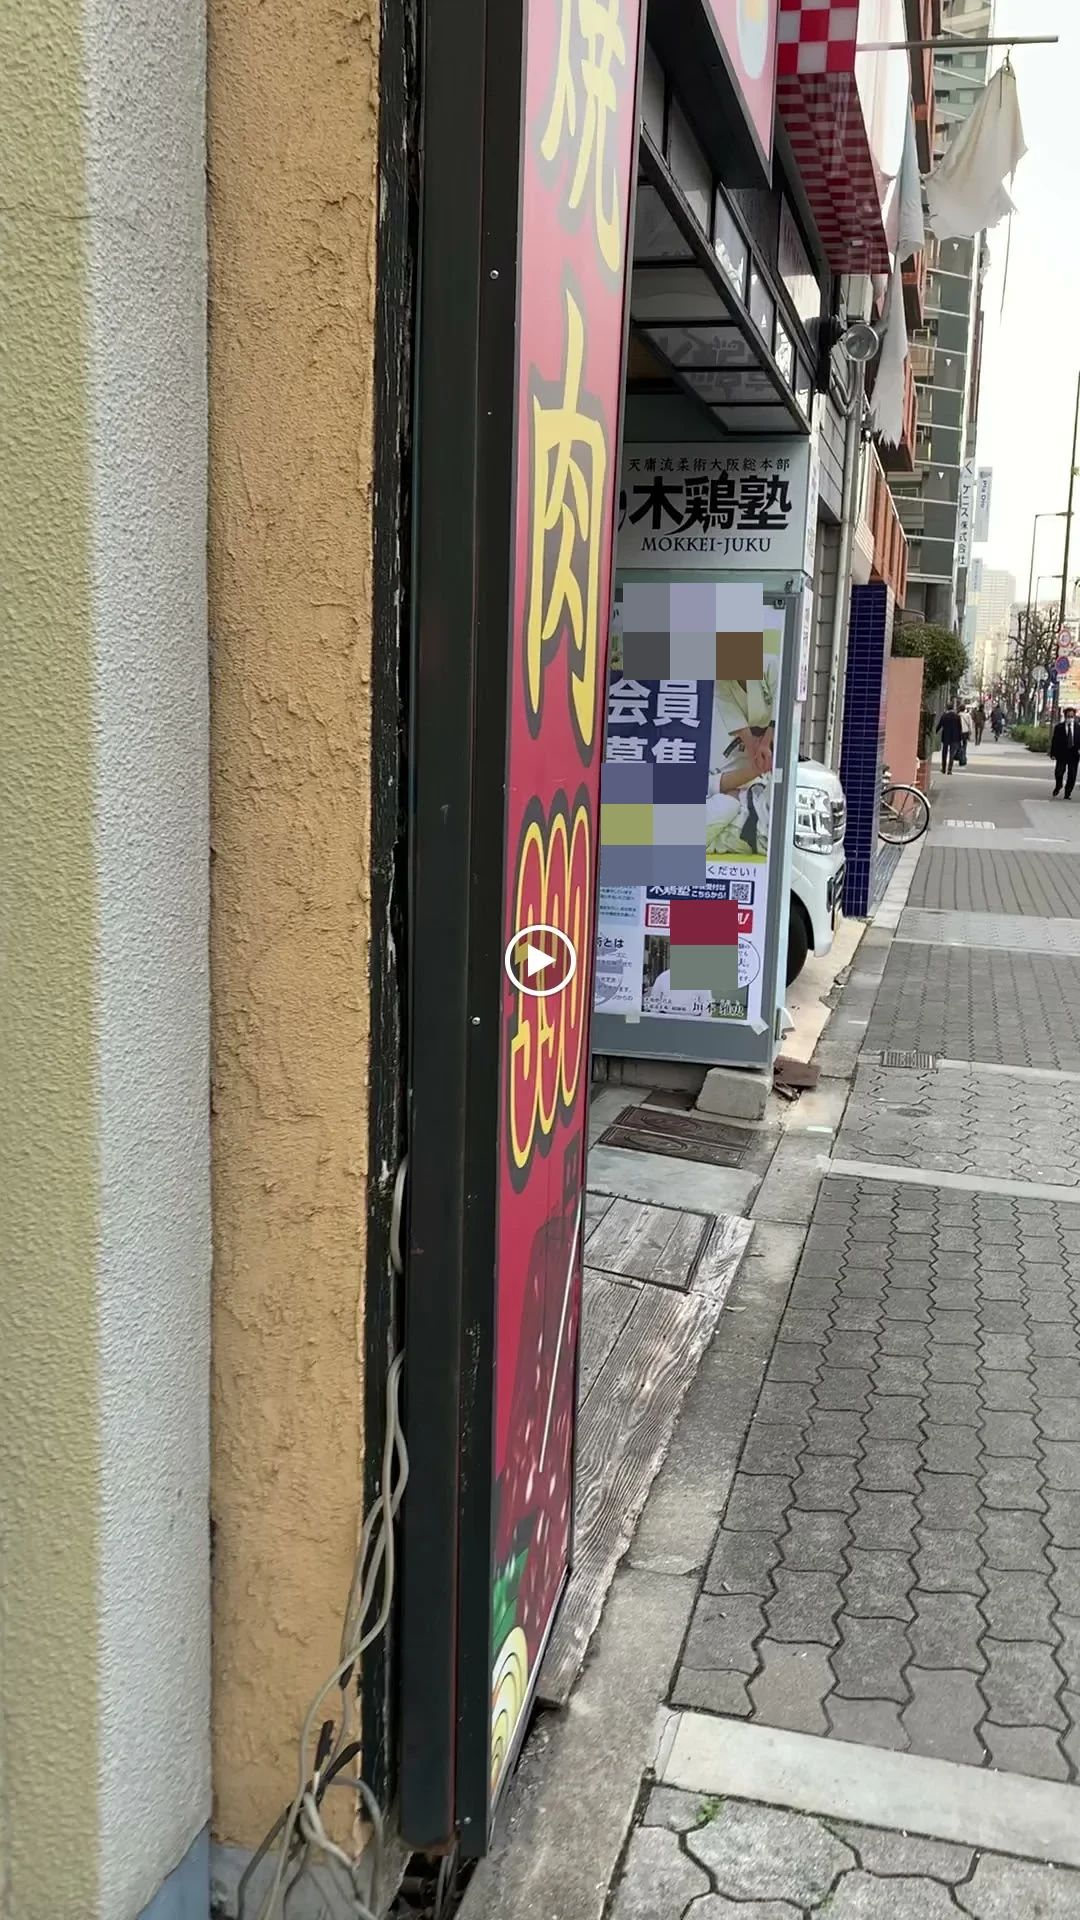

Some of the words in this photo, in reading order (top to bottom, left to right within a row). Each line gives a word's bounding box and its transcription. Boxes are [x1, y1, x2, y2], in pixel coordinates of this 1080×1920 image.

[629, 471, 792, 535] 木鶏塾
[641, 537, 772, 555] MOKKEI-JUKU
[608, 677, 701, 728] 会員
